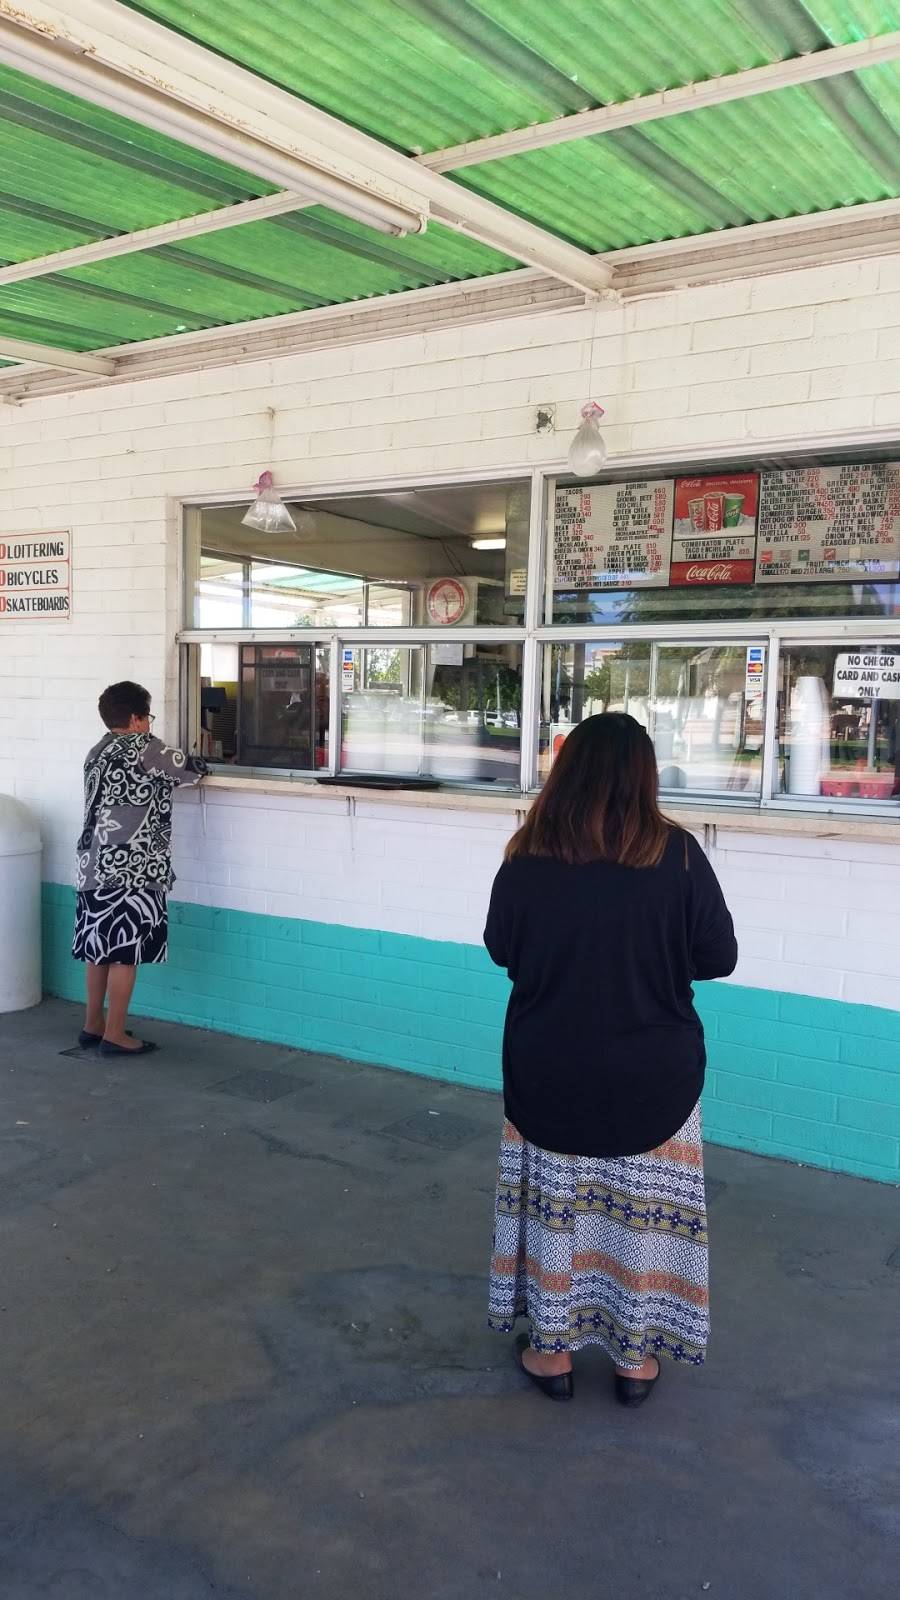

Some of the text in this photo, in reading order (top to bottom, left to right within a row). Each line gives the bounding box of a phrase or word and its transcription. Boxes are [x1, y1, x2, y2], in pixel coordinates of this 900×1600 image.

[852, 511, 889, 519] SANDWICH
[820, 539, 857, 547] SEASONED
[7, 541, 64, 559] LOITERING
[7, 569, 59, 586] BICYCLES
[6, 596, 69, 612] SKATEBOARDS
[847, 655, 895, 667] NO CHECKS
[836, 670, 859, 681] CARD
[860, 671, 880, 681] AND
